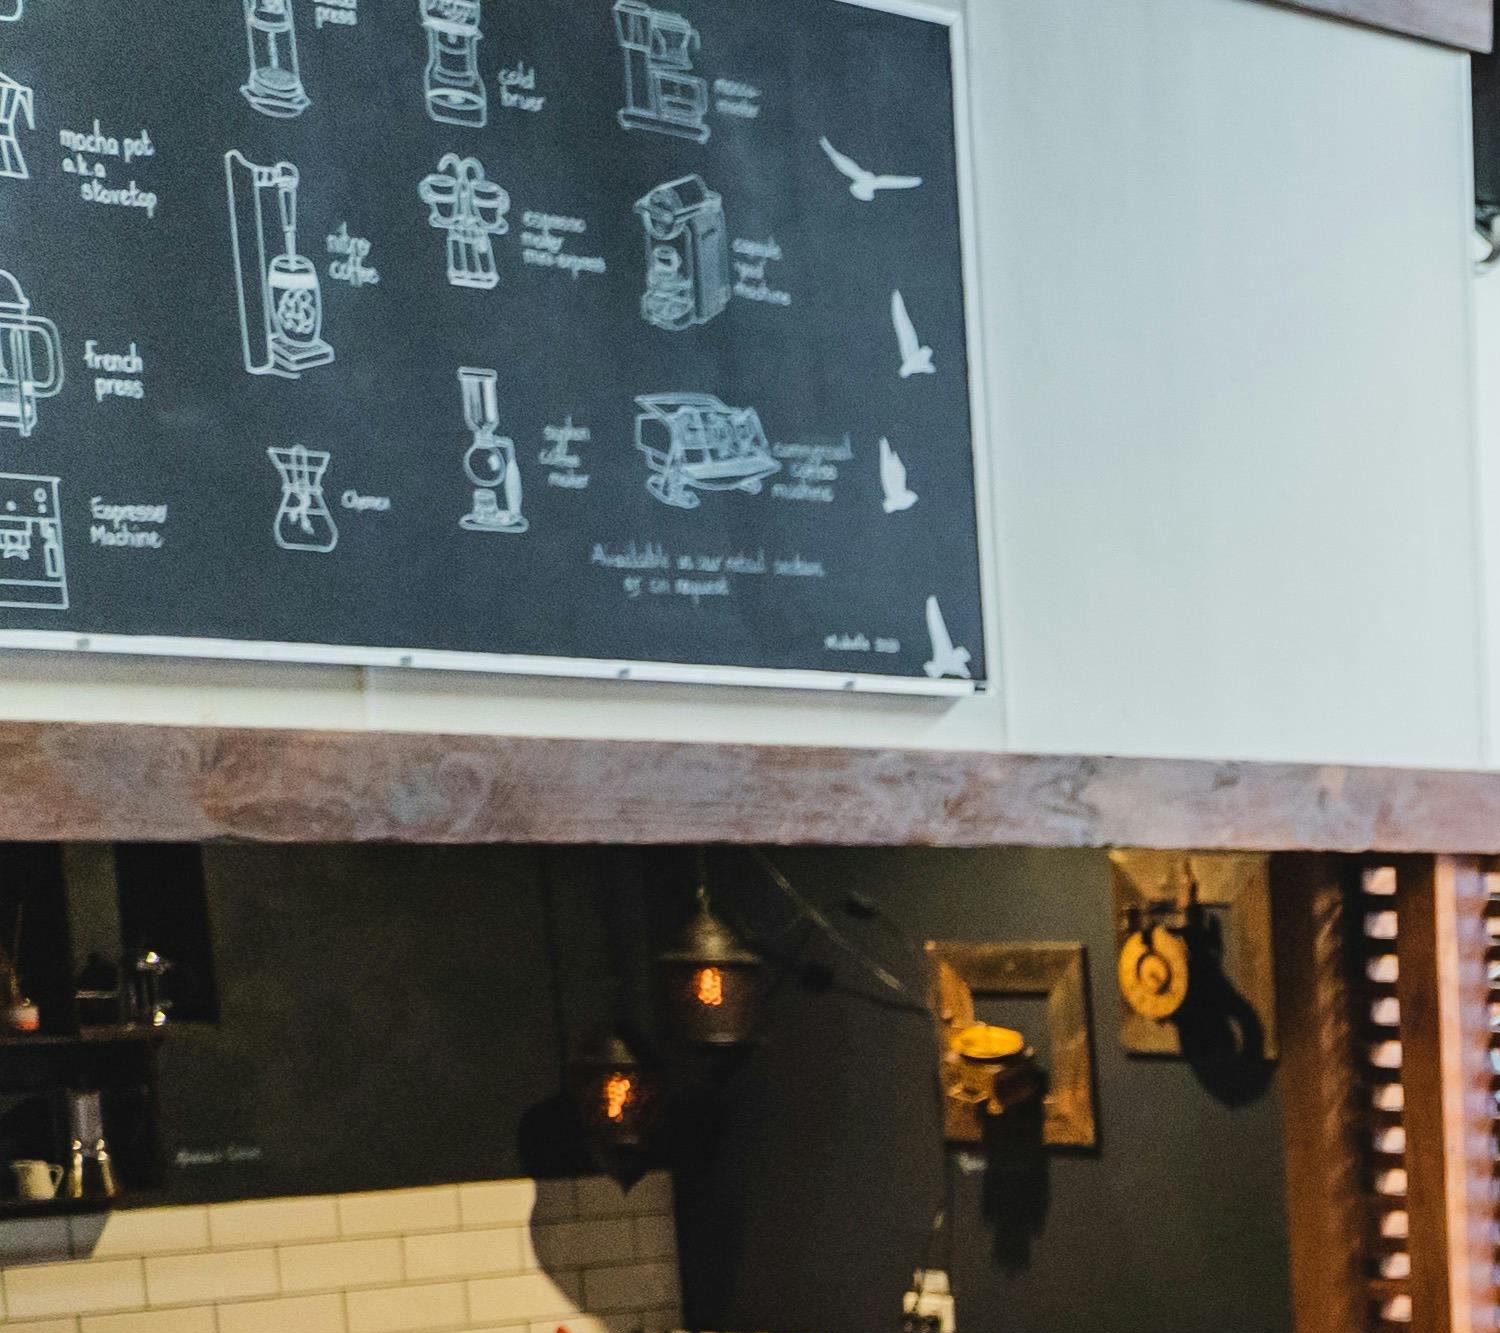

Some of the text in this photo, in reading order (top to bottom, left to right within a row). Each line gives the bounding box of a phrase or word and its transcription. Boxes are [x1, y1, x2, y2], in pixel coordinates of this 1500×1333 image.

[123, 129, 155, 163] pot
[80, 178, 157, 219] stovetop
[94, 377, 144, 401] press
